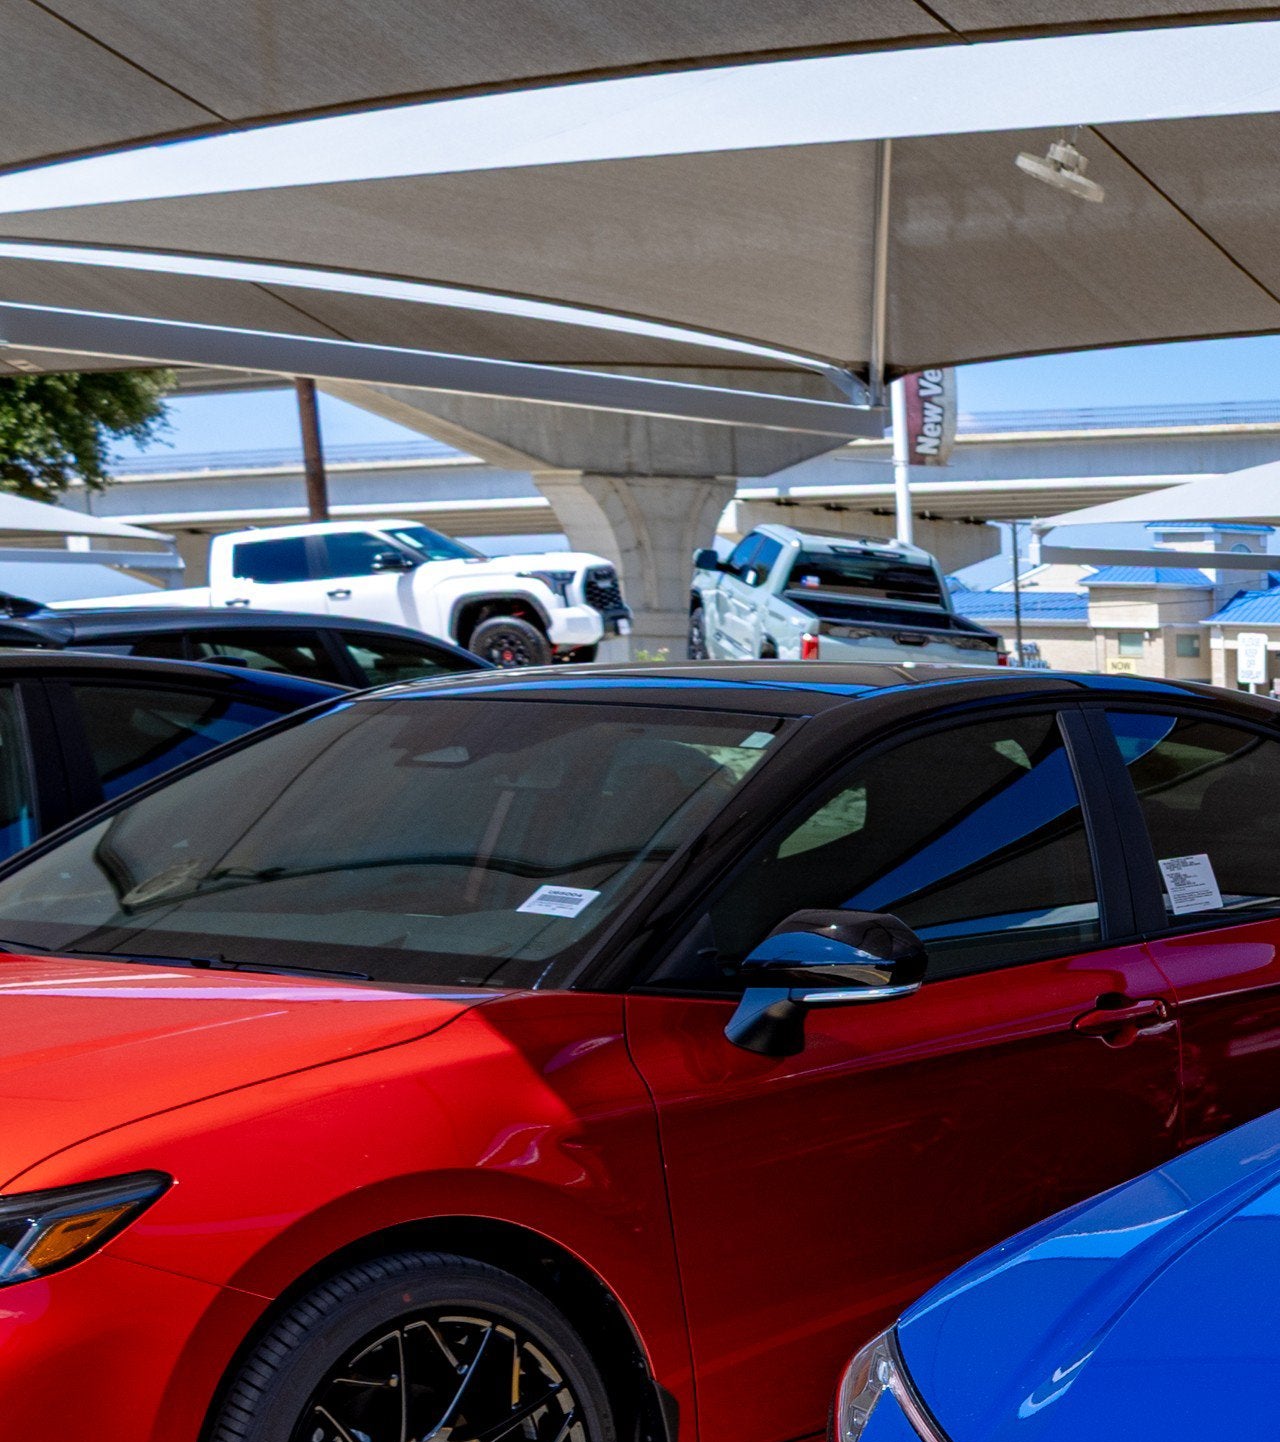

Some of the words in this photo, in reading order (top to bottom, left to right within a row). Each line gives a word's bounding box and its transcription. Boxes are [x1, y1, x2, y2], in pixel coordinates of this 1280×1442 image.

[917, 368, 944, 398] Ve
[915, 401, 943, 456] New
[1111, 661, 1131, 670] NOW
